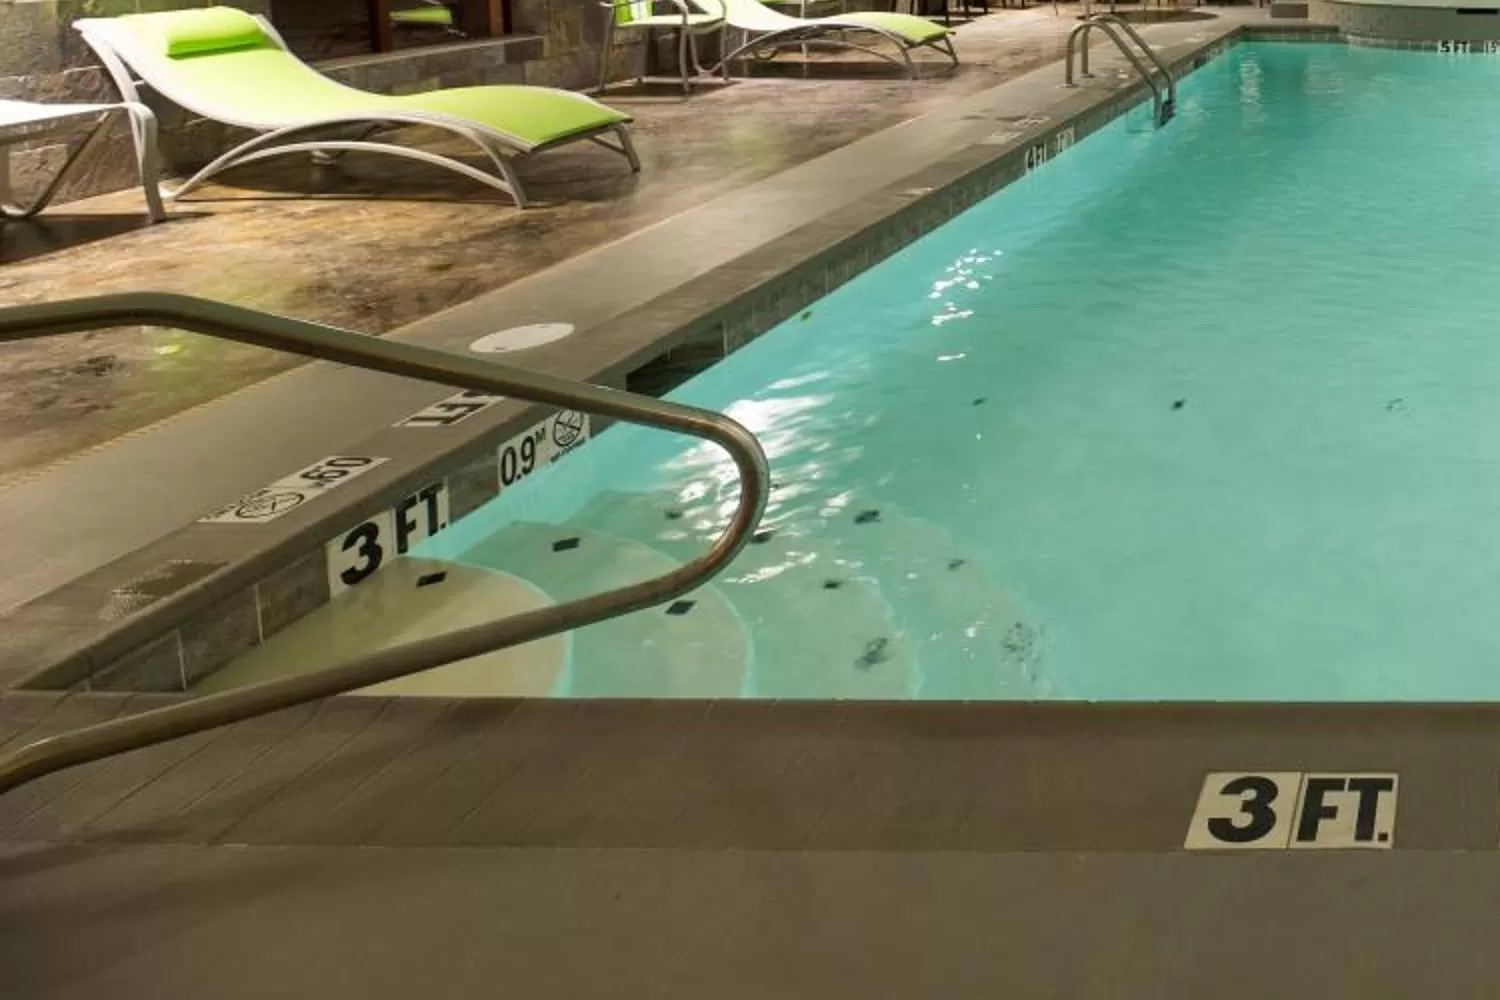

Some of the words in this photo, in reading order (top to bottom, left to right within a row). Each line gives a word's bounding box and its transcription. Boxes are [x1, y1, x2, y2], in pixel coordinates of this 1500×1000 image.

[341, 522, 383, 586] 3
[397, 484, 447, 554] FT.
[1207, 776, 1279, 843] 3
[1296, 778, 1394, 842] FT.
